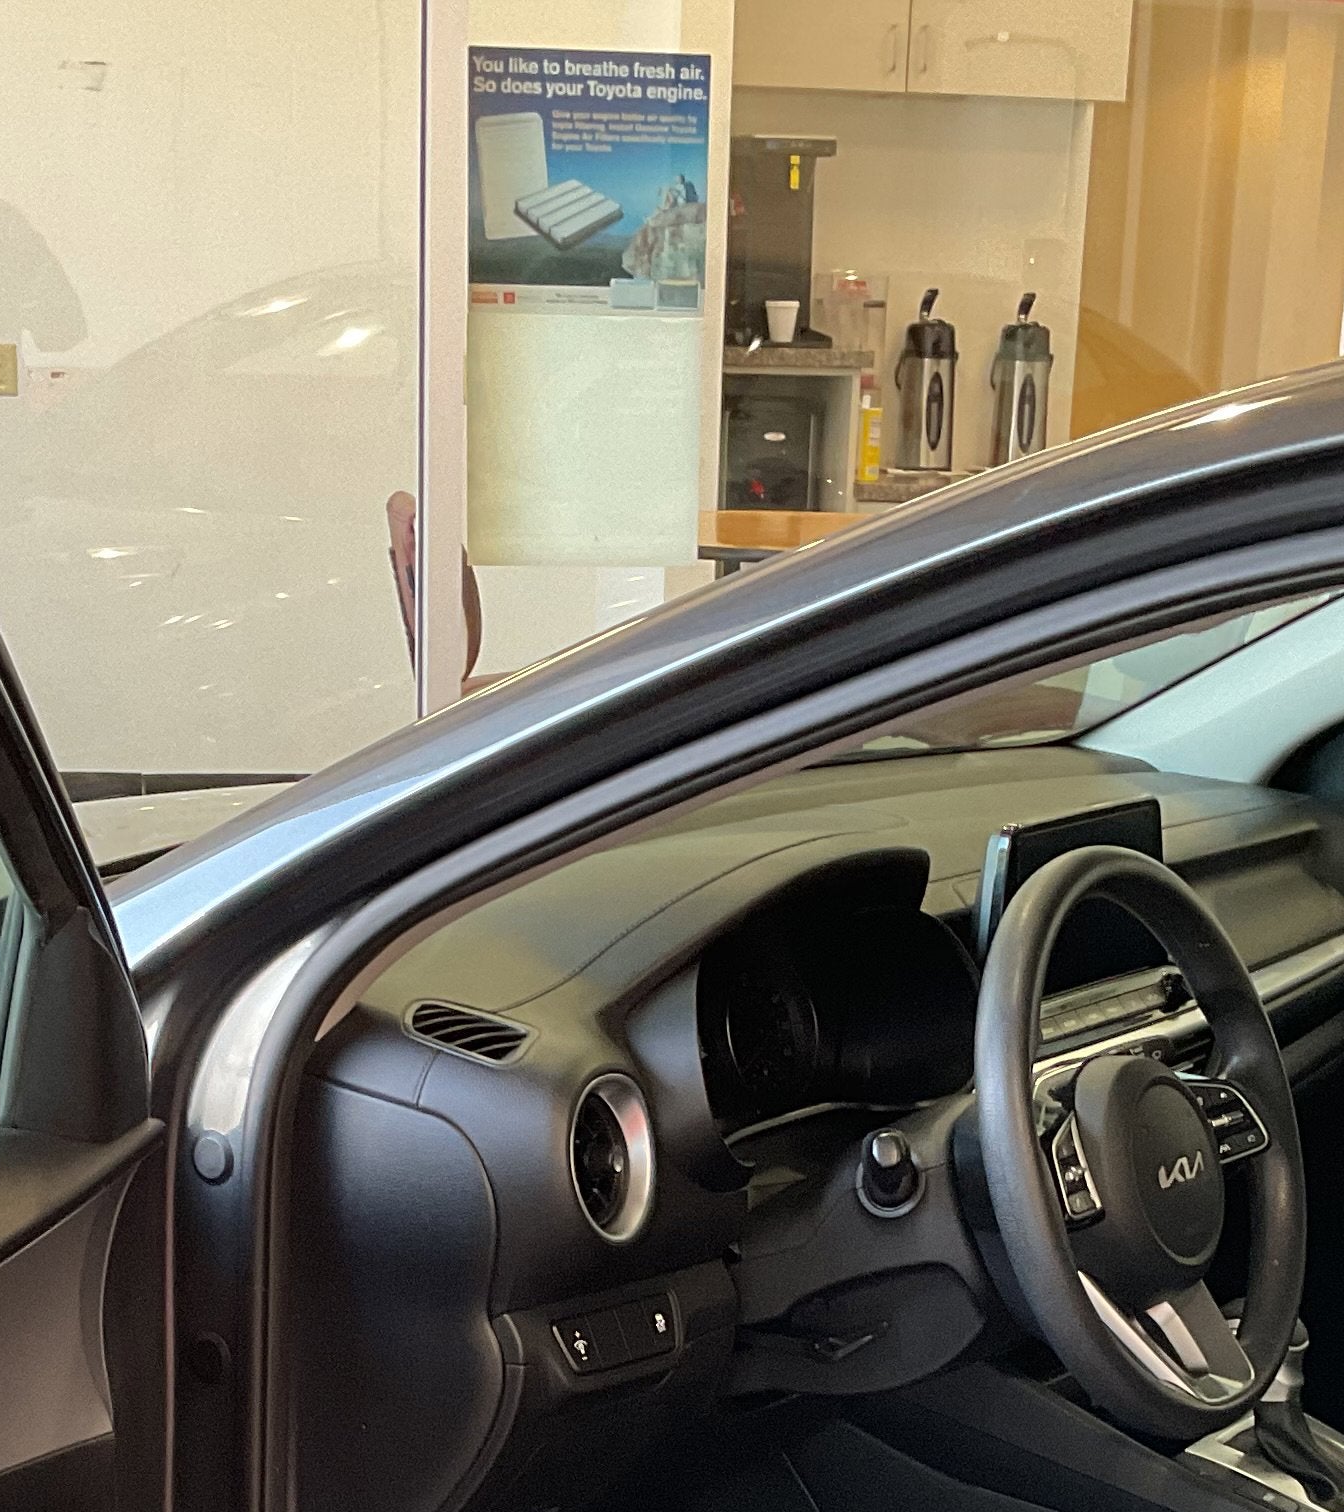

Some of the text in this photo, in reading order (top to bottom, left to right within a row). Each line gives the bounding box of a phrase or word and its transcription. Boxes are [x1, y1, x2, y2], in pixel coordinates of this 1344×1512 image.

[472, 56, 705, 81] You like to breathe fresh air.
[473, 77, 708, 104] So does your Toyota engine.
